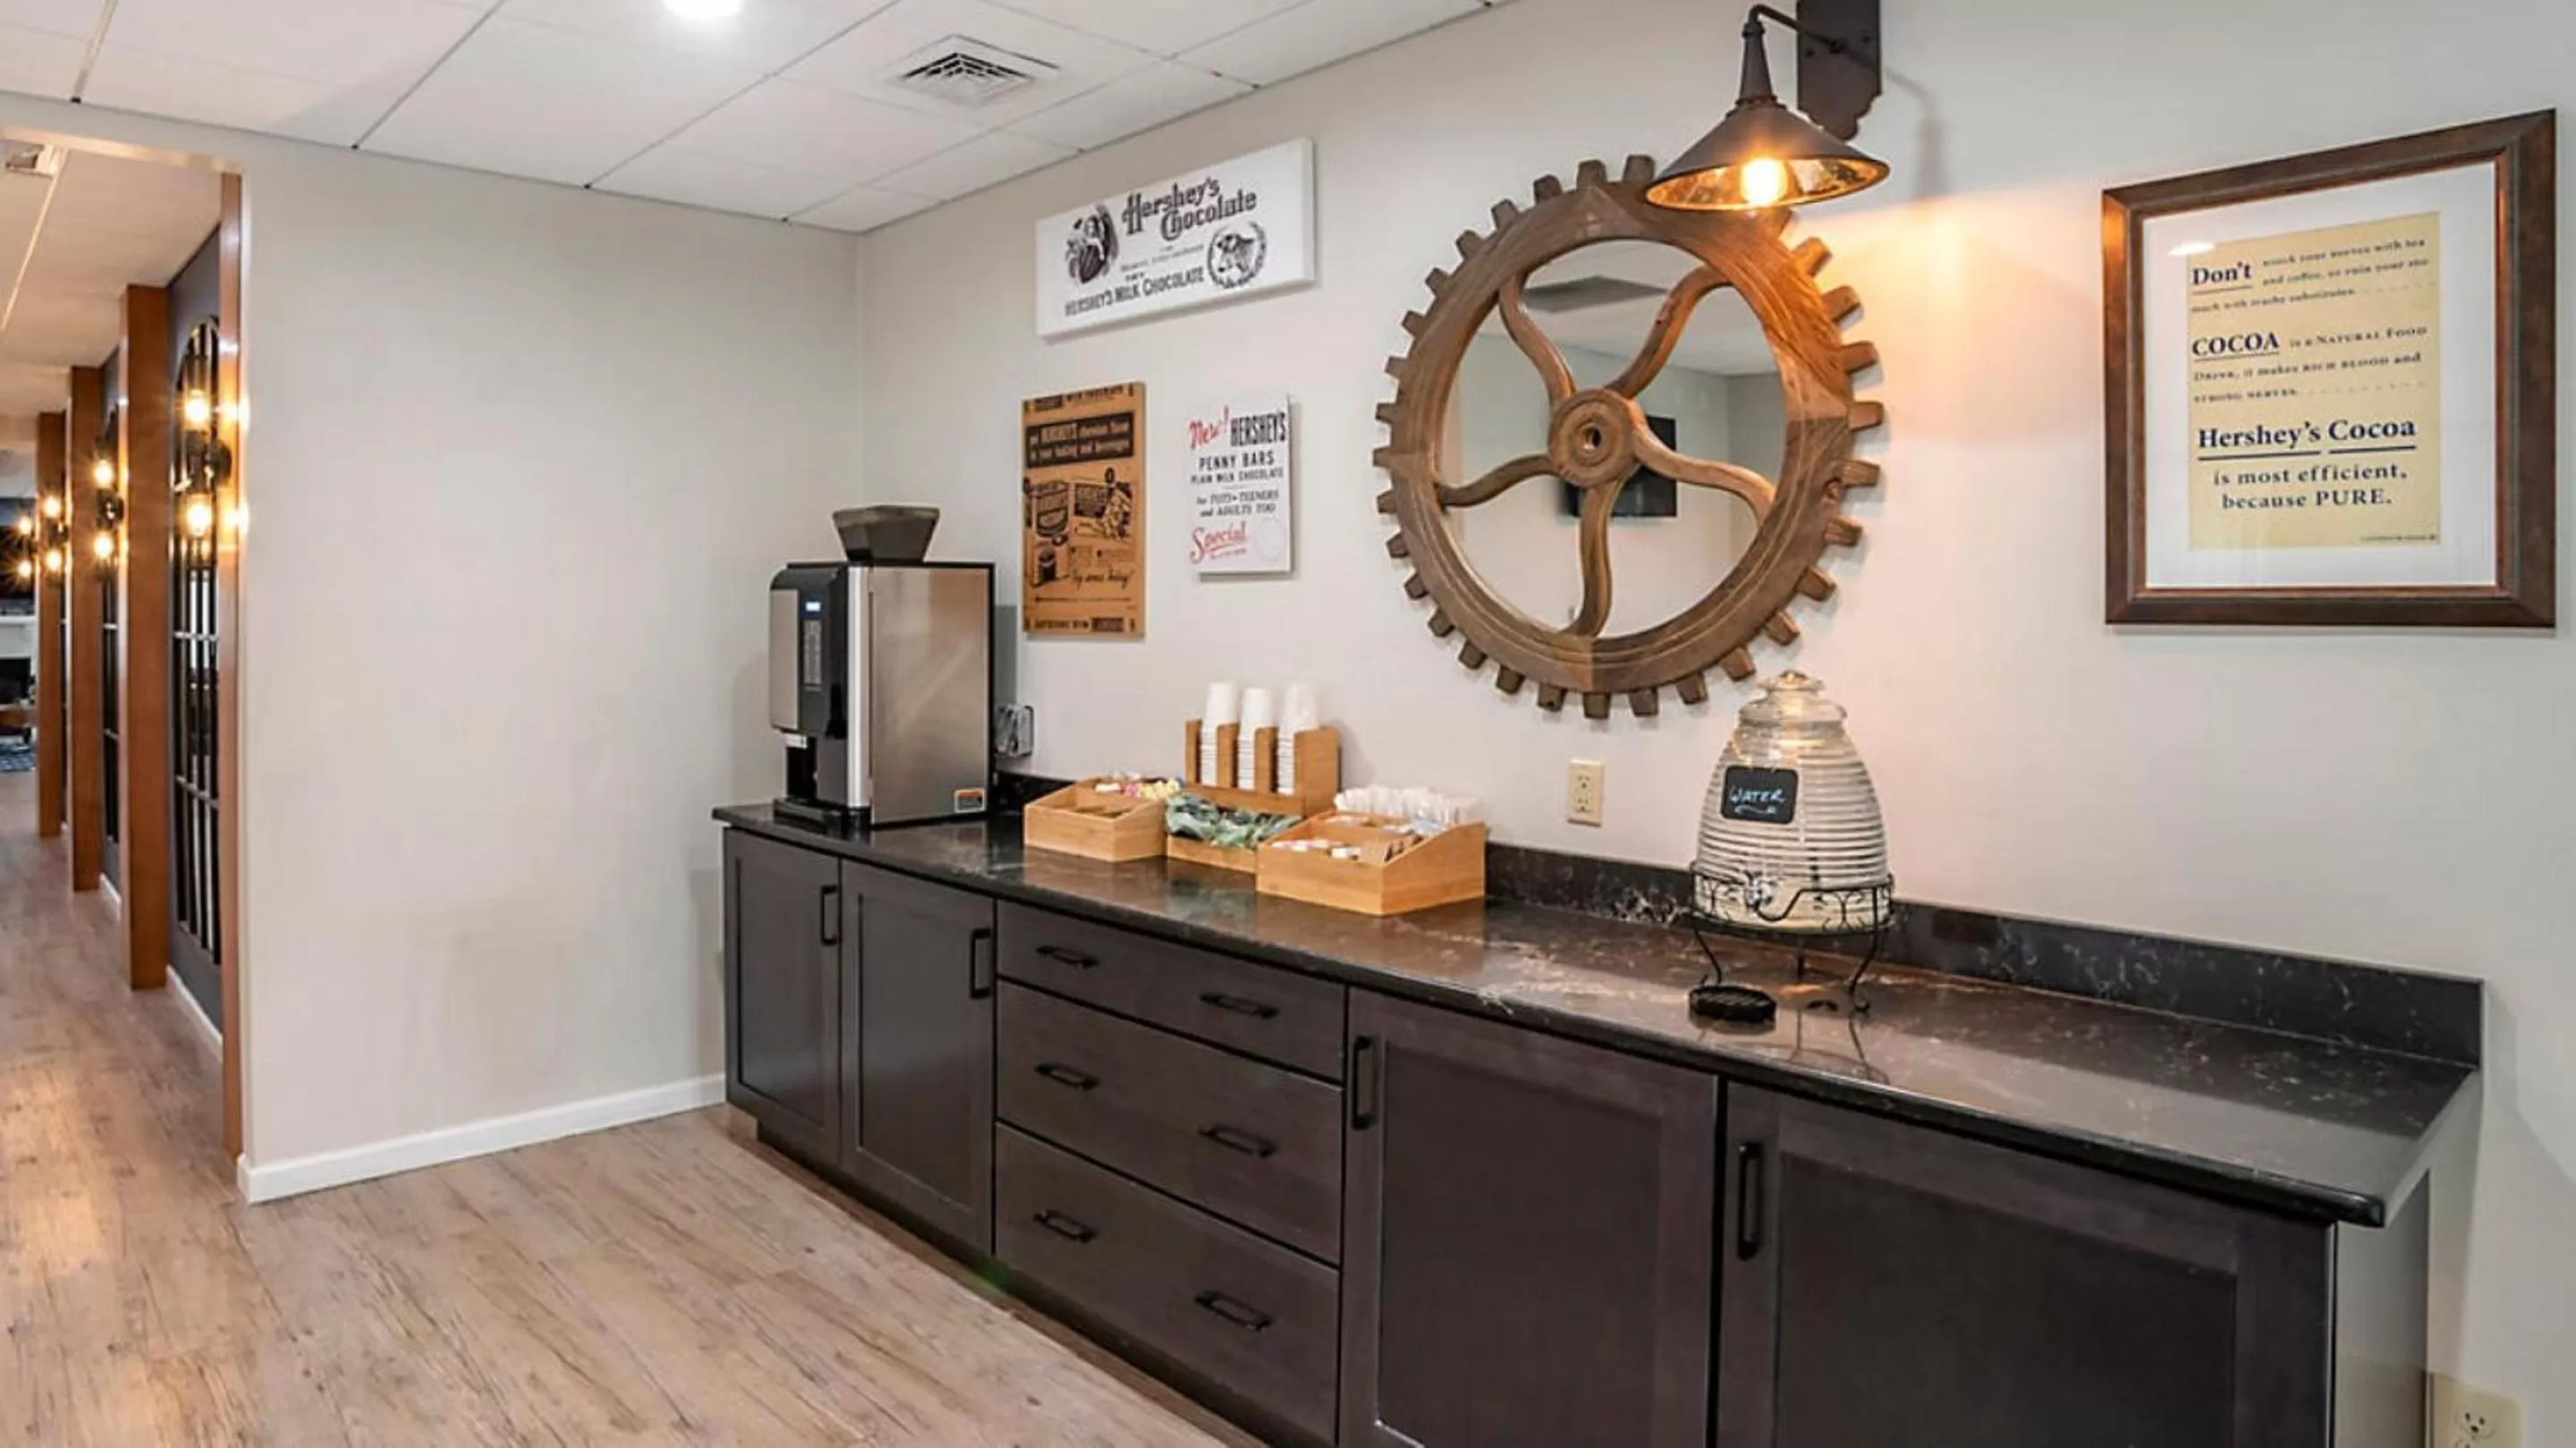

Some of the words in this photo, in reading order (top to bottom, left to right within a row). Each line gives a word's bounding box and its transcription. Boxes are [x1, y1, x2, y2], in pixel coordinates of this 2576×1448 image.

[1122, 177, 1220, 236] Hershey's
[1161, 190, 1258, 241] Chocolate
[1142, 266, 1205, 296] CHOCOLATE
[2192, 260, 2251, 285] Don't
[2192, 332, 2280, 356] COCOA
[2198, 420, 2321, 450] Hershey's
[2327, 419, 2416, 441] Cocoa
[1199, 453, 1236, 471] PENNY
[1241, 451, 1275, 469] BARS
[1239, 467, 1284, 481] CHOCOLATE
[2214, 470, 2230, 487] is
[2238, 468, 2290, 485] most
[2298, 462, 2407, 484] efficient,
[2222, 494, 2308, 510] because
[2315, 488, 2393, 506] PURE.
[1729, 785, 1786, 803] WATER
